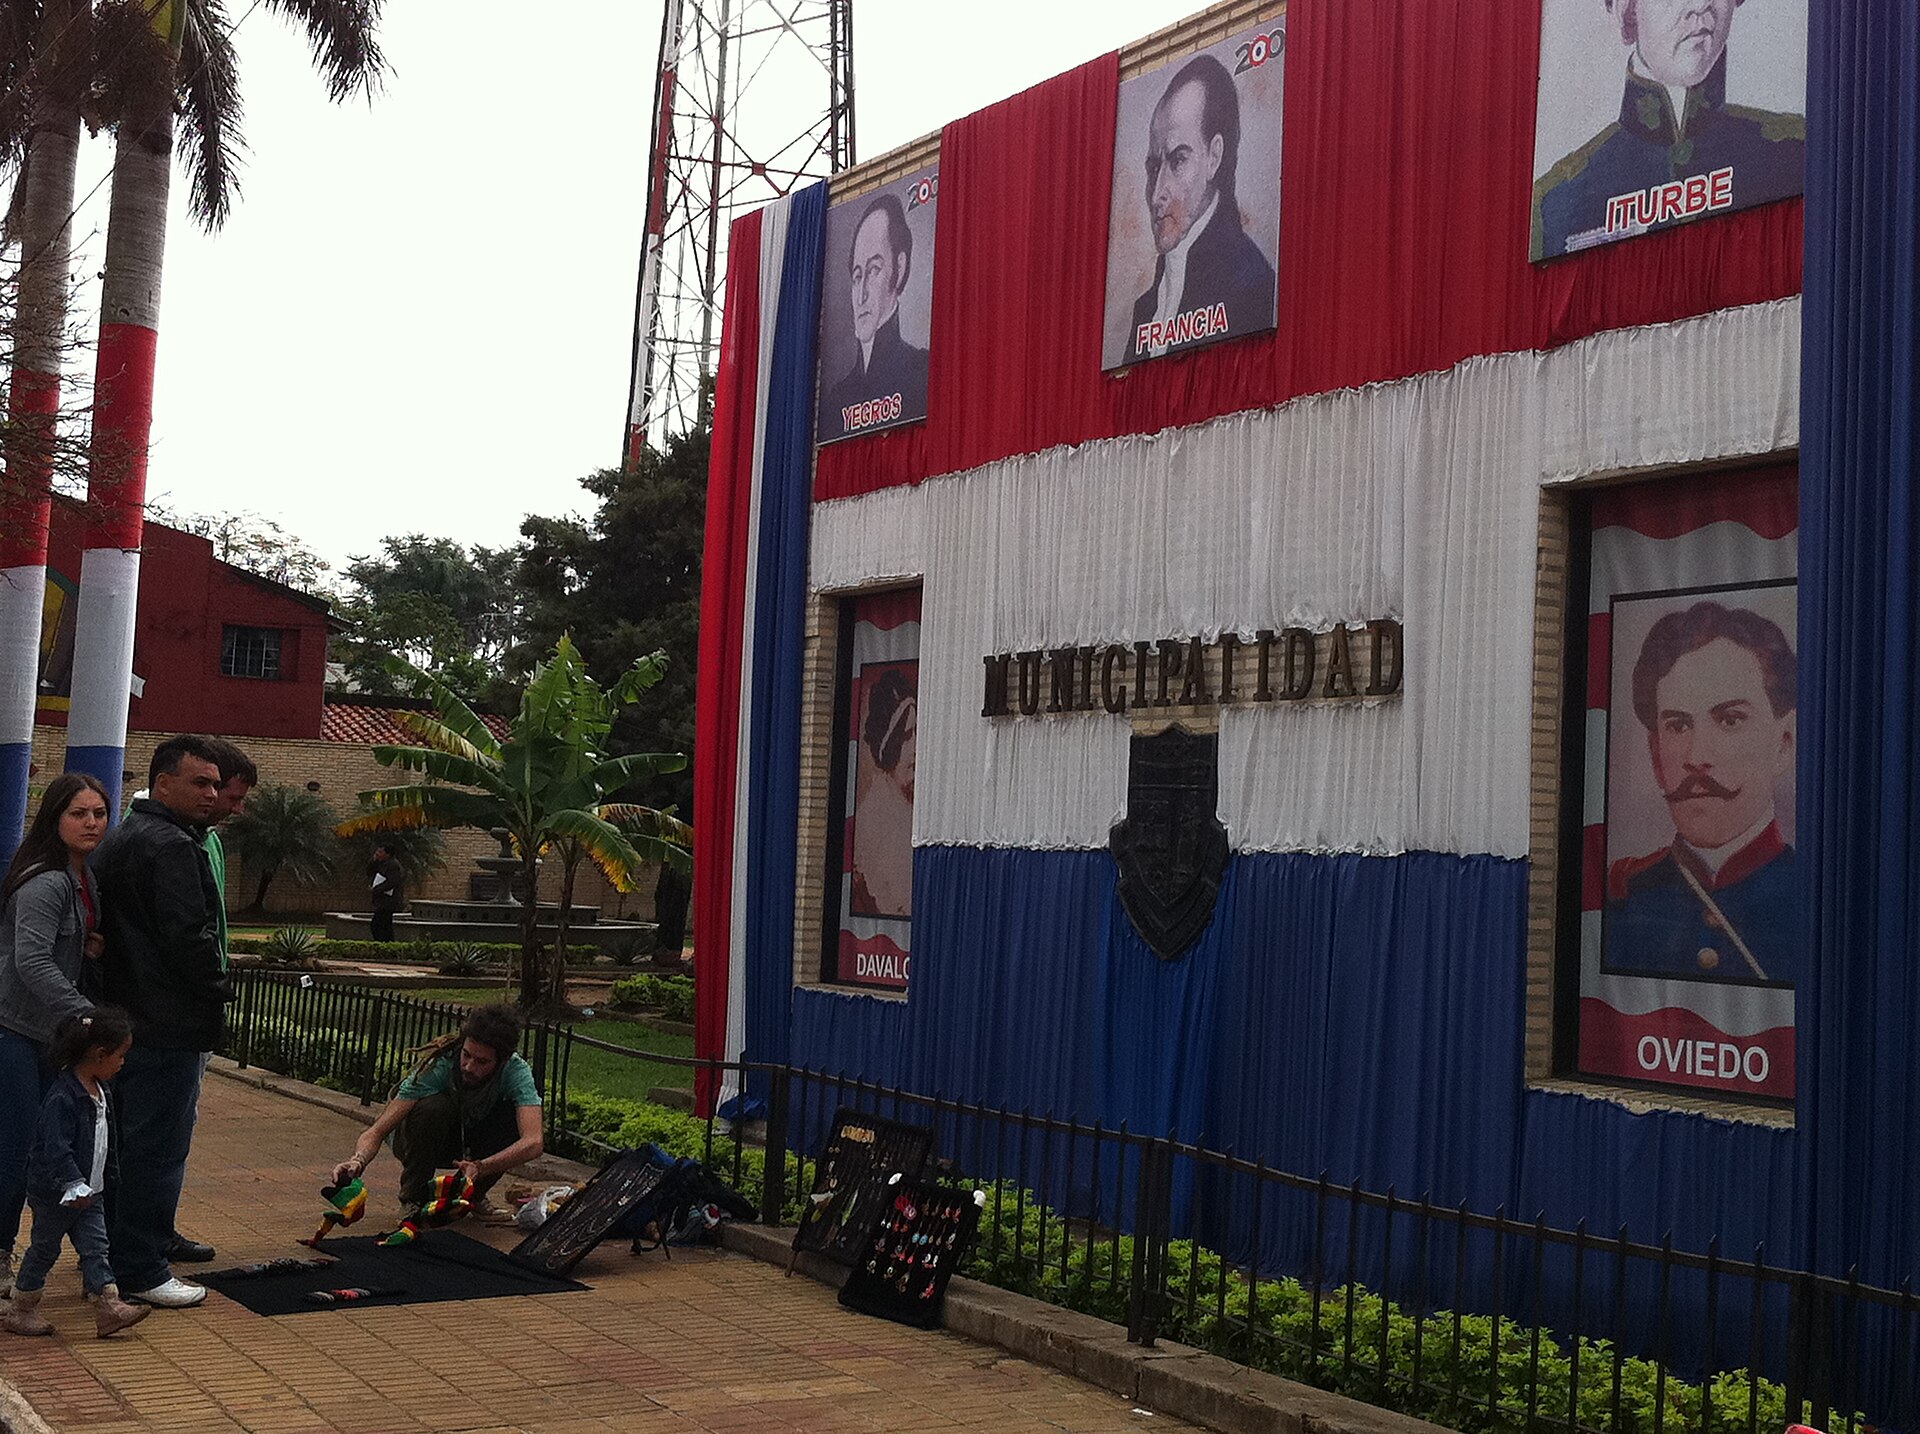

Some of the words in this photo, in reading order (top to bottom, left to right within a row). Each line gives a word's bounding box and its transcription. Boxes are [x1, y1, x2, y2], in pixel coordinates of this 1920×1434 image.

[1233, 27, 1286, 76] 200
[1605, 166, 1733, 234] ITURBE
[1135, 302, 1229, 355] FRANCIA
[842, 393, 902, 432] YEGROS
[1637, 1035, 1769, 1083] OVIEDO
